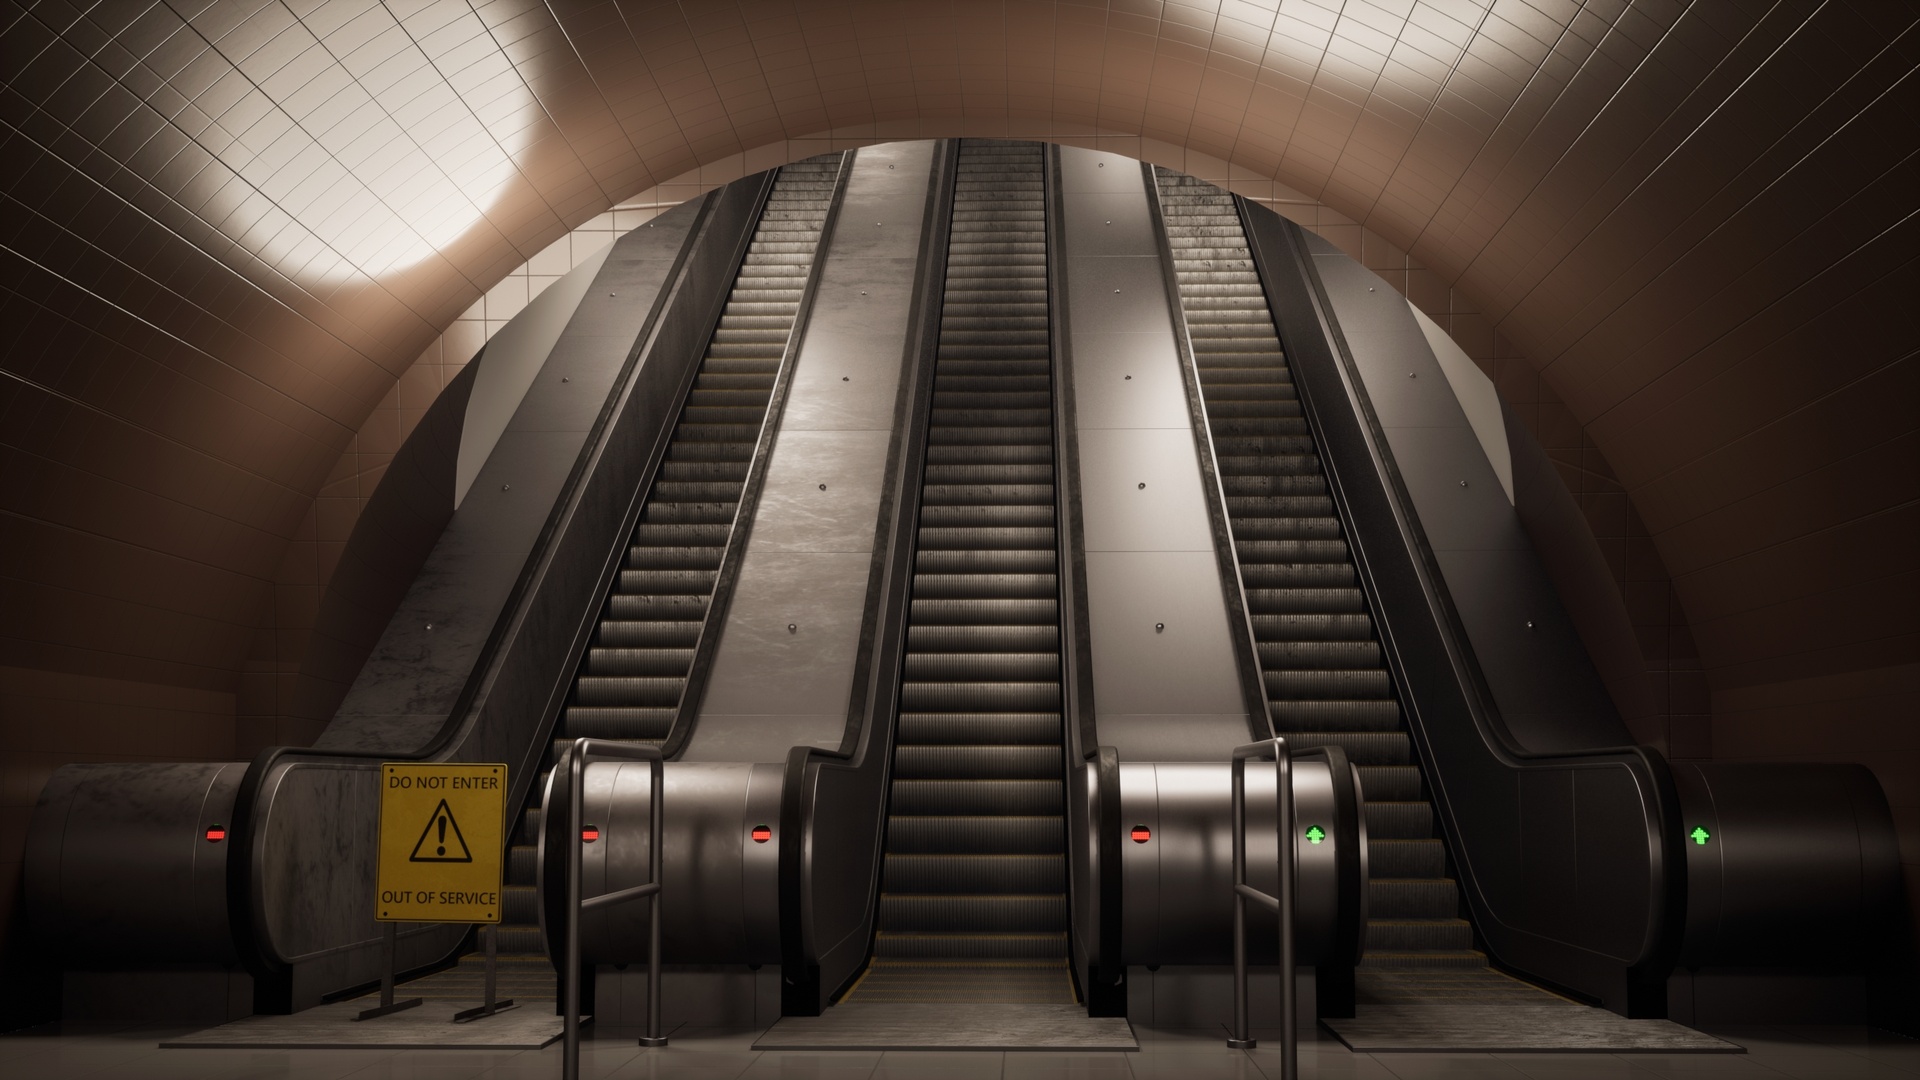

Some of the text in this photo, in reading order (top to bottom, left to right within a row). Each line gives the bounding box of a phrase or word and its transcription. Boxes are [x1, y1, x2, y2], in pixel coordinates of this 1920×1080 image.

[389, 776, 499, 790] DO NOT ENTER
[381, 890, 497, 905] OUT OF SERVICE
